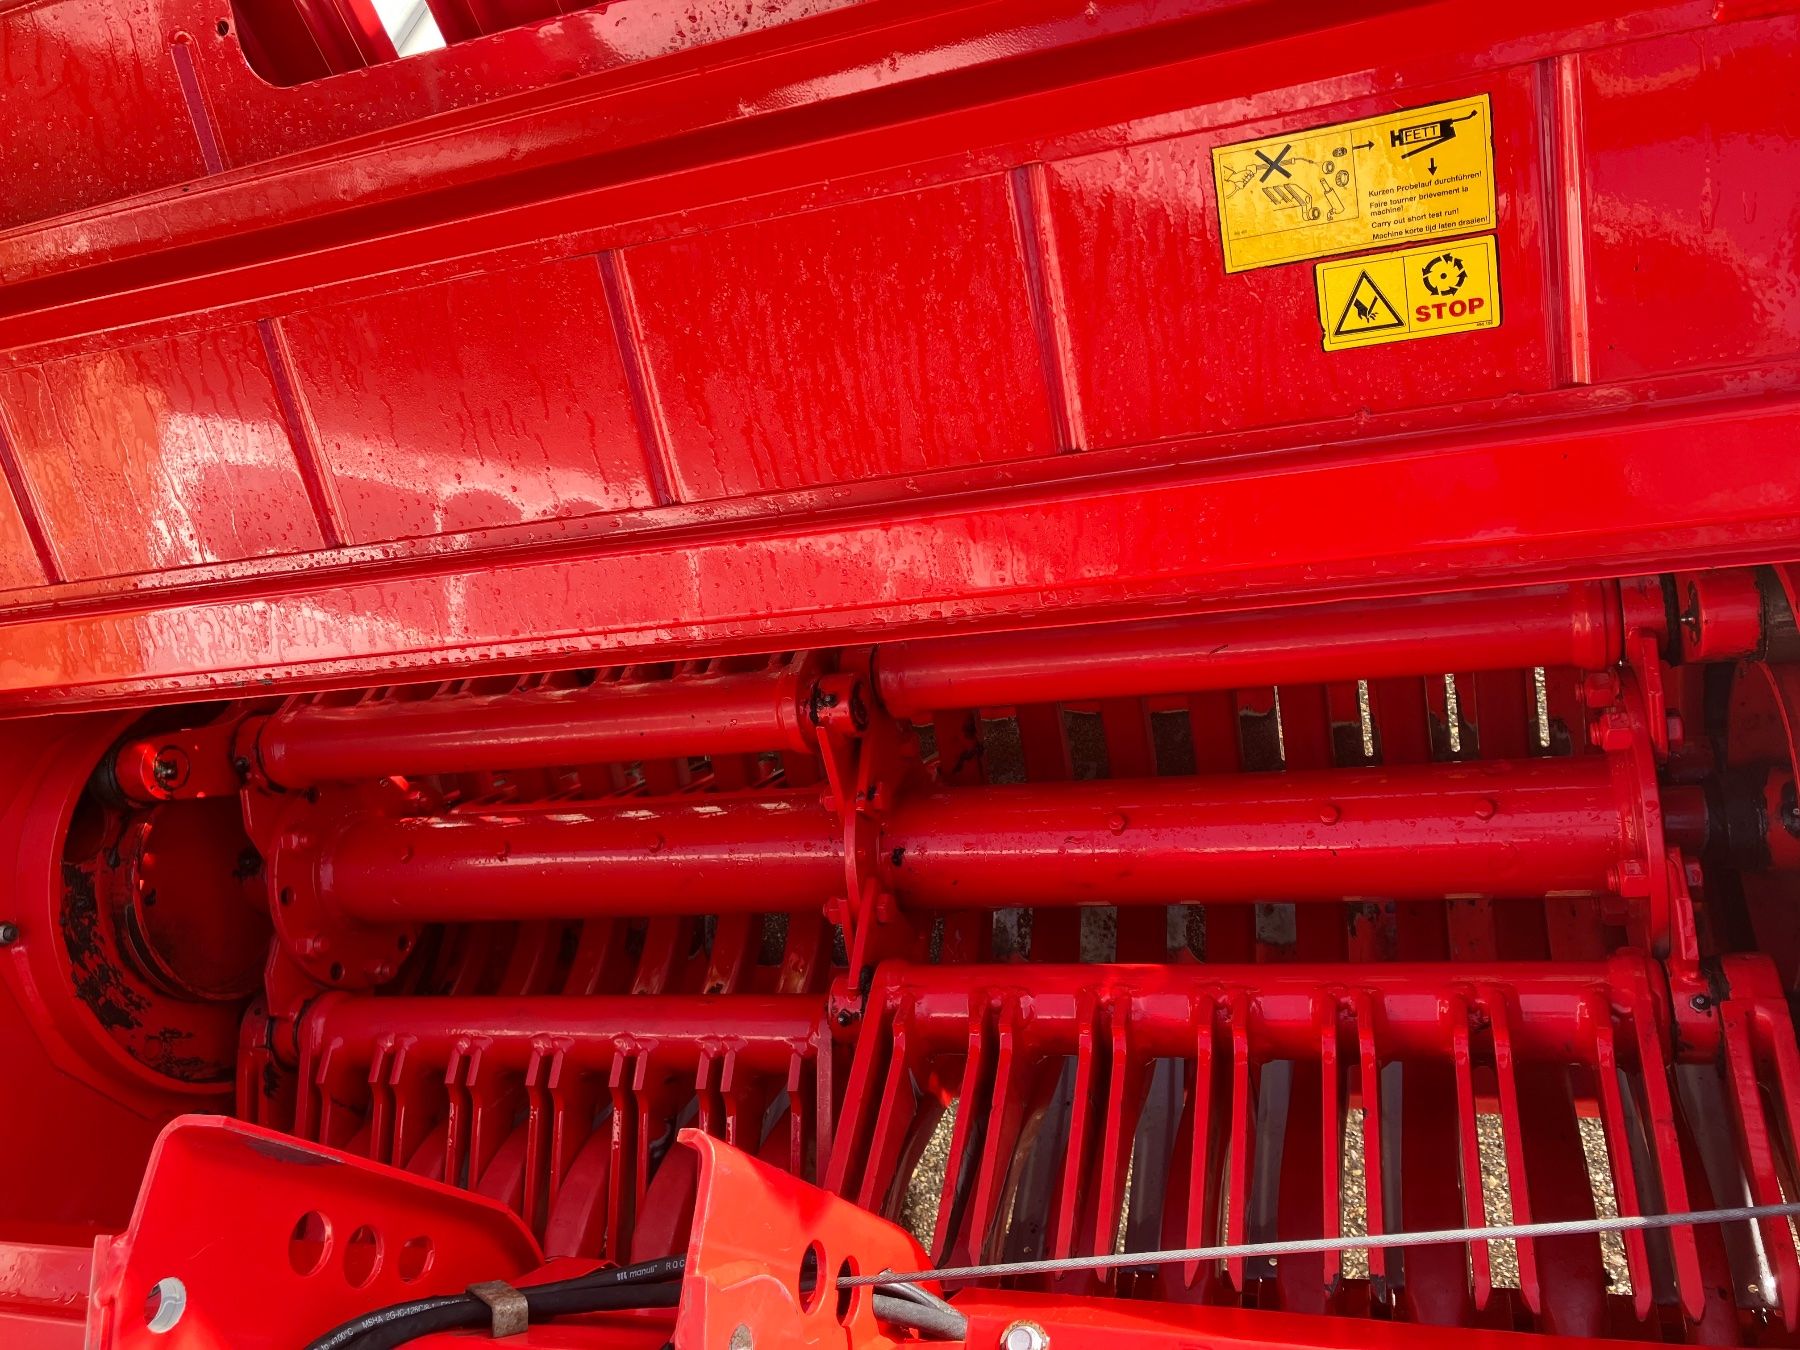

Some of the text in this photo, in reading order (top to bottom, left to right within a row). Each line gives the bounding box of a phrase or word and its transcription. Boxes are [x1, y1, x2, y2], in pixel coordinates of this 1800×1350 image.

[1404, 124, 1438, 142] FETT
[1368, 187, 1395, 198] Kurzen
[1396, 180, 1432, 192] Probelauf
[1369, 199, 1388, 209] Faire
[1390, 195, 1417, 206] tourner
[1461, 185, 1469, 193] la
[1370, 204, 1404, 217] machine!
[1371, 208, 1459, 229] Carry out short test run!
[1372, 215, 1488, 240] Machine korte tijd laten draaien!
[1415, 297, 1485, 323] STOP
[361, 1315, 384, 1329] MSHA
